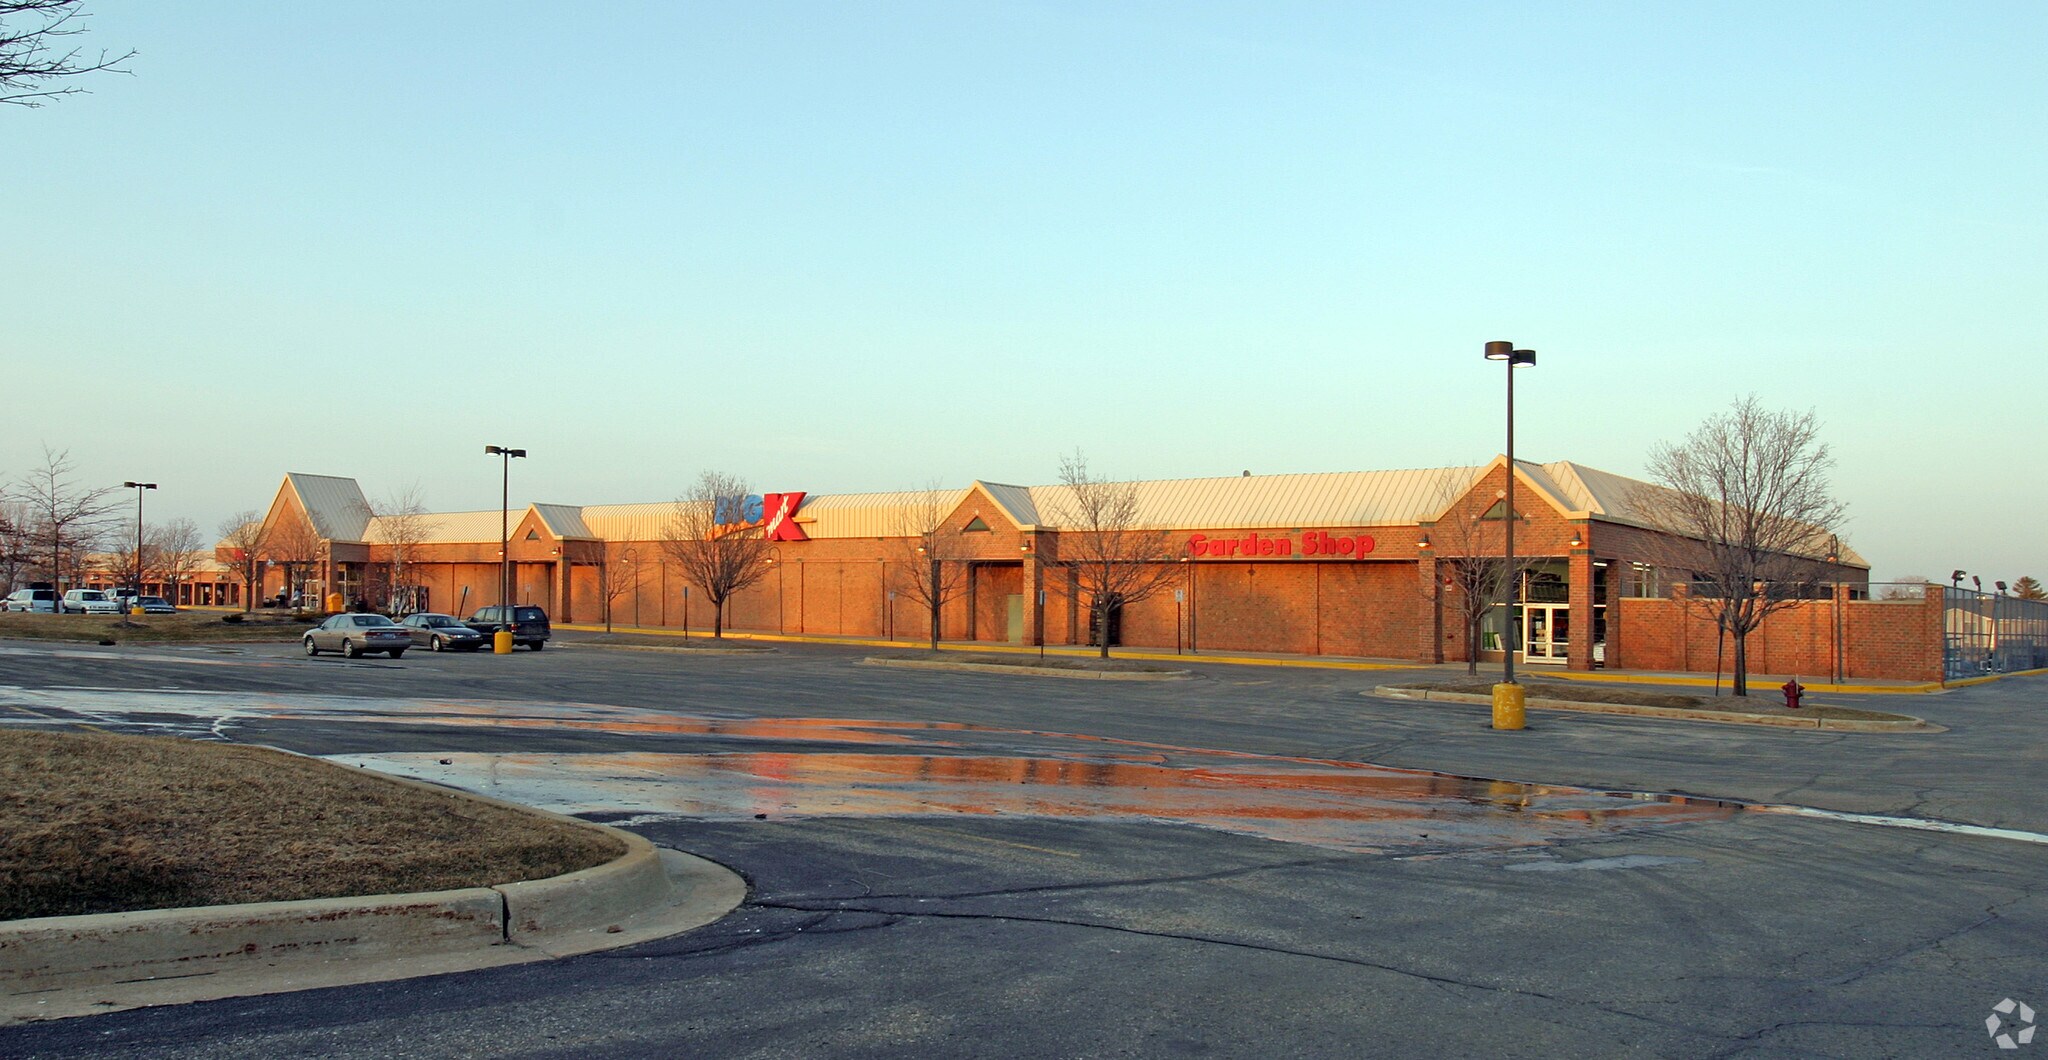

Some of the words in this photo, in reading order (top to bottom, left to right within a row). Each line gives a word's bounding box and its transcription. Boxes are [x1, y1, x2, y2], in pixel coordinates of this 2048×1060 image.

[714, 494, 764, 525] BIG
[763, 492, 808, 541] K
[1188, 533, 1292, 556] Garden
[1301, 531, 1375, 560] Shop
